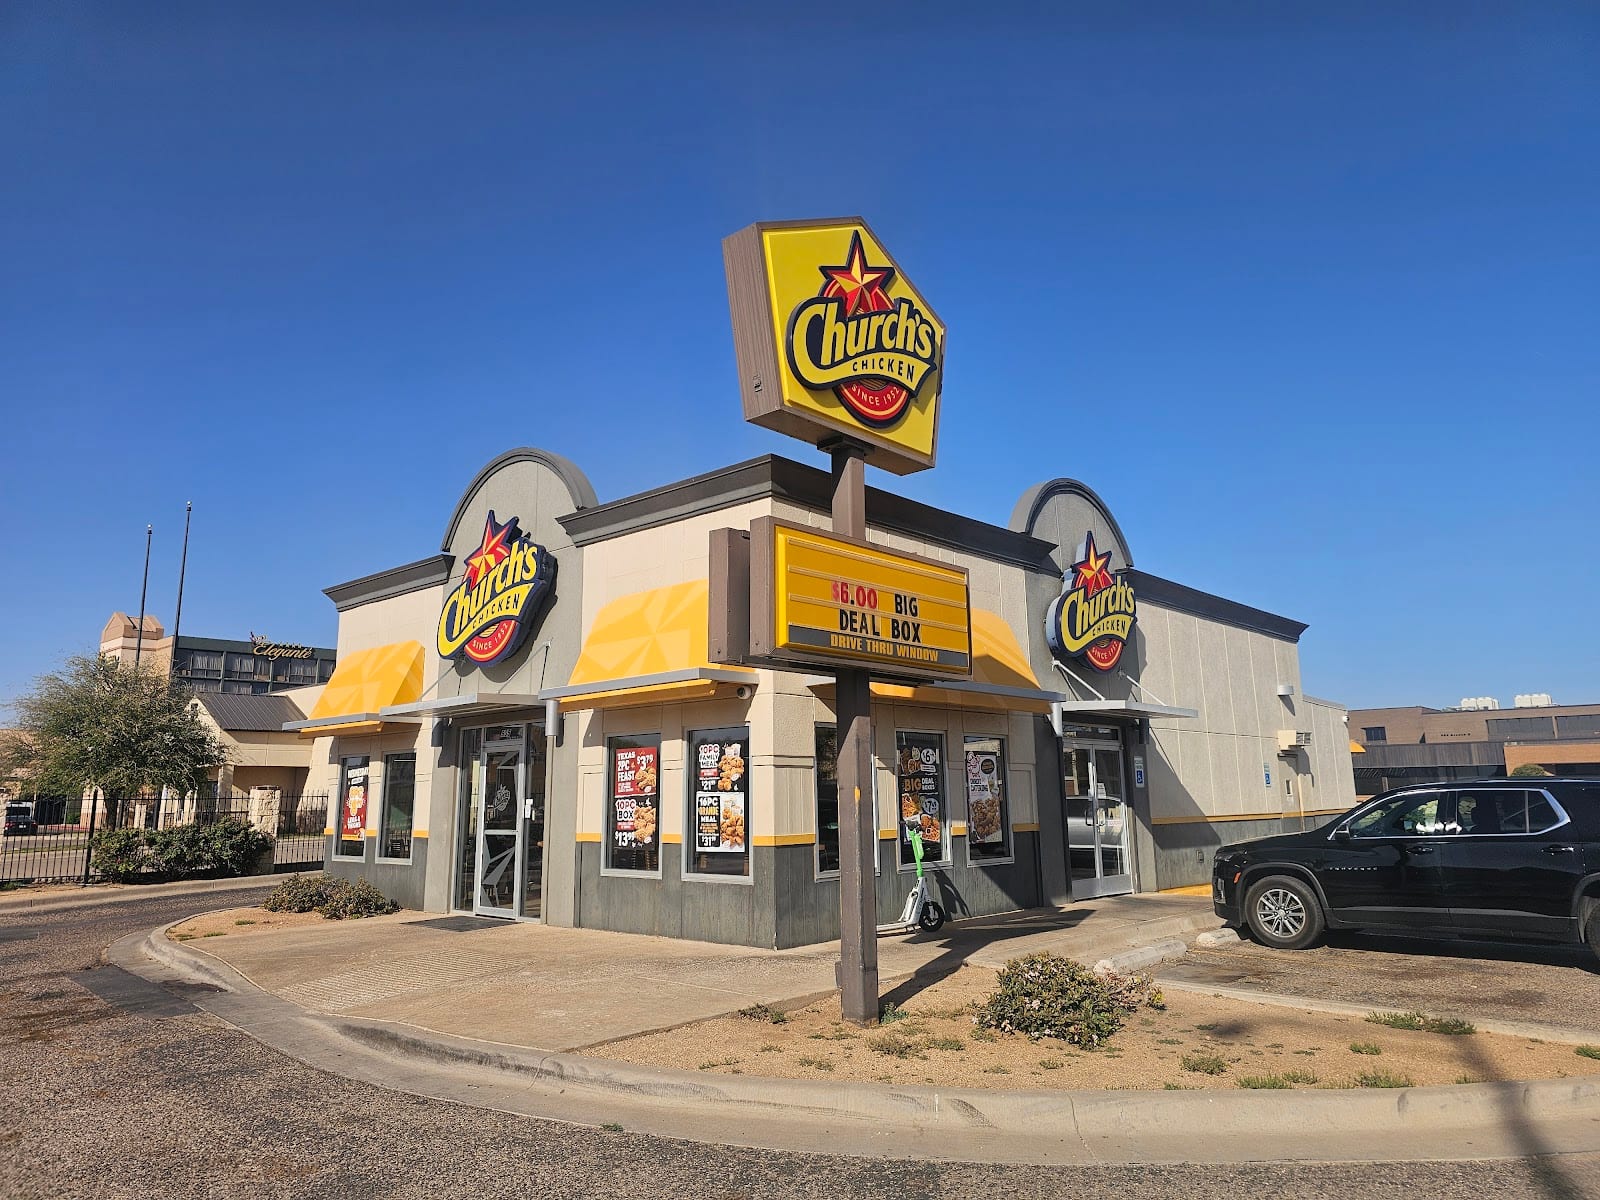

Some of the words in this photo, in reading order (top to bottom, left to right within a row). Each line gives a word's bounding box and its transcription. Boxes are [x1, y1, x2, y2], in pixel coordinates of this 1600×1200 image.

[793, 302, 932, 382] Church's
[852, 358, 915, 383] CHICKEN
[851, 383, 880, 406] SINCE
[883, 386, 900, 405] 1952
[438, 541, 537, 656] Church's
[831, 581, 878, 610] $6.00
[894, 594, 918, 617] BIG
[472, 594, 520, 630] CHICKEN
[1061, 576, 1135, 652] Church's
[839, 609, 880, 635] DEAL
[891, 619, 921, 643] BOX
[1092, 621, 1126, 637] CHICKEN
[472, 639, 492, 649] SINCE
[830, 634, 862, 651] DRIVE
[866, 639, 893, 655] THRU
[896, 644, 938, 662] WINDOW
[617, 751, 636, 760] TEXAS
[618, 760, 630, 771] 2PC
[618, 770, 635, 782] FEAST
[904, 778, 922, 791] BIG
[616, 800, 636, 810] 10PC
[618, 810, 634, 819] BOX
